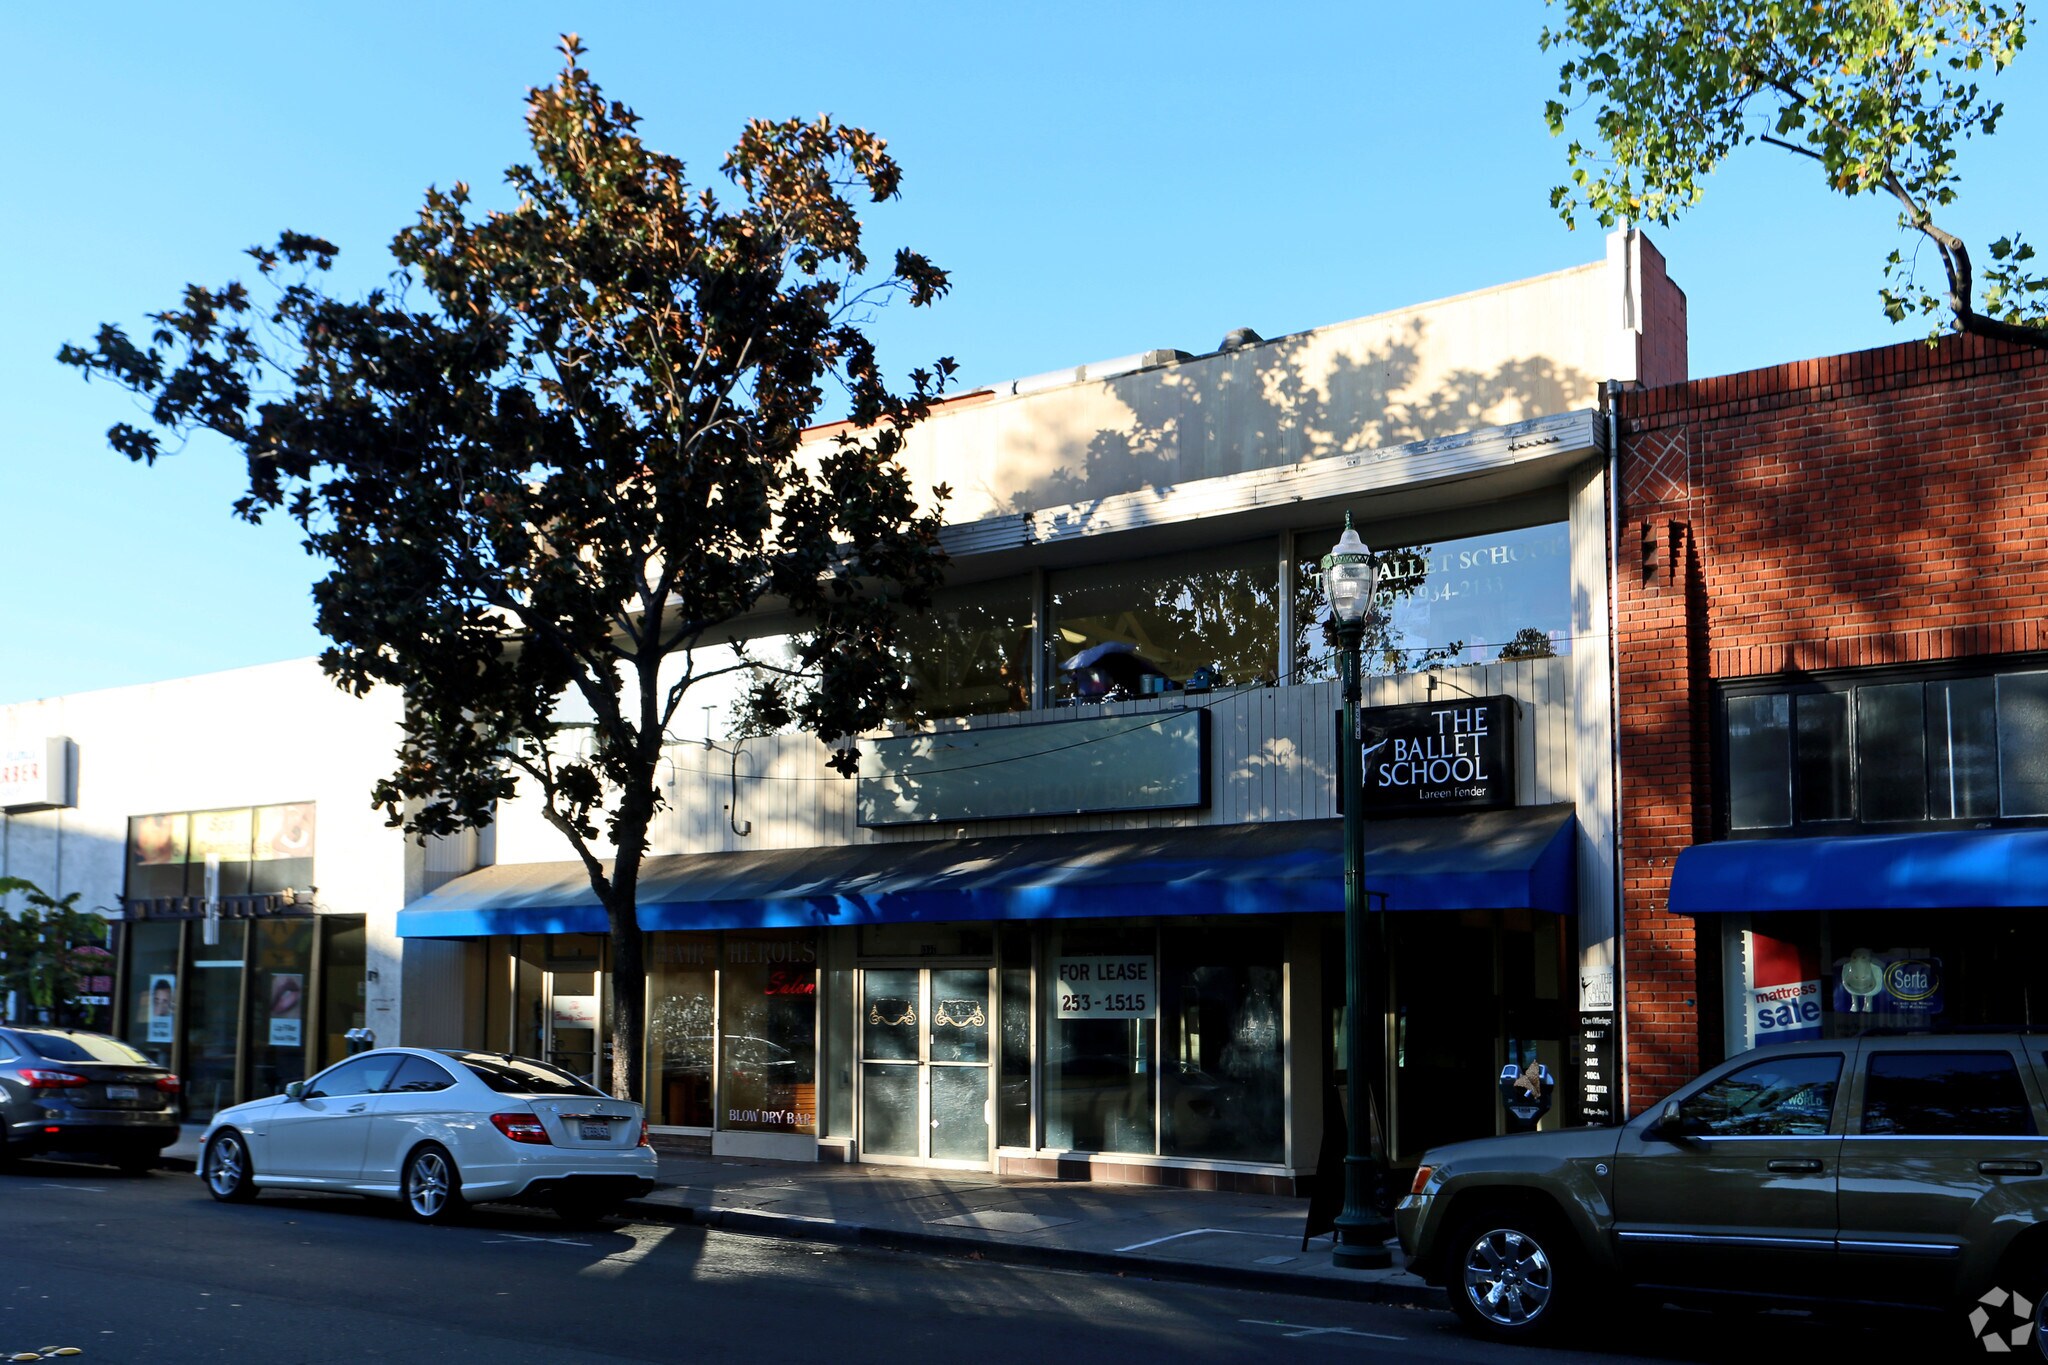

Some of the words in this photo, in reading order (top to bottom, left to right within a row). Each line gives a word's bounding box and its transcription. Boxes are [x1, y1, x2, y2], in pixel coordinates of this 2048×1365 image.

[1377, 553, 1454, 582] ALLET
[1431, 706, 1488, 735] THE
[1393, 731, 1488, 763] BALLET
[1378, 756, 1489, 788] SCHOOL
[1419, 787, 1453, 800] Lareen
[1455, 785, 1487, 798] Fender
[729, 939, 818, 965] HEROES
[1059, 963, 1091, 982] FOR
[1097, 963, 1148, 982] LEASE
[1894, 969, 1928, 989] Serta
[1062, 994, 1146, 1013] 253-1515
[1755, 983, 1817, 1004] mattress
[1757, 997, 1820, 1029] sale
[728, 1107, 759, 1123] BLOW
[761, 1108, 787, 1125] DRY
[787, 1111, 812, 1127] BAR
